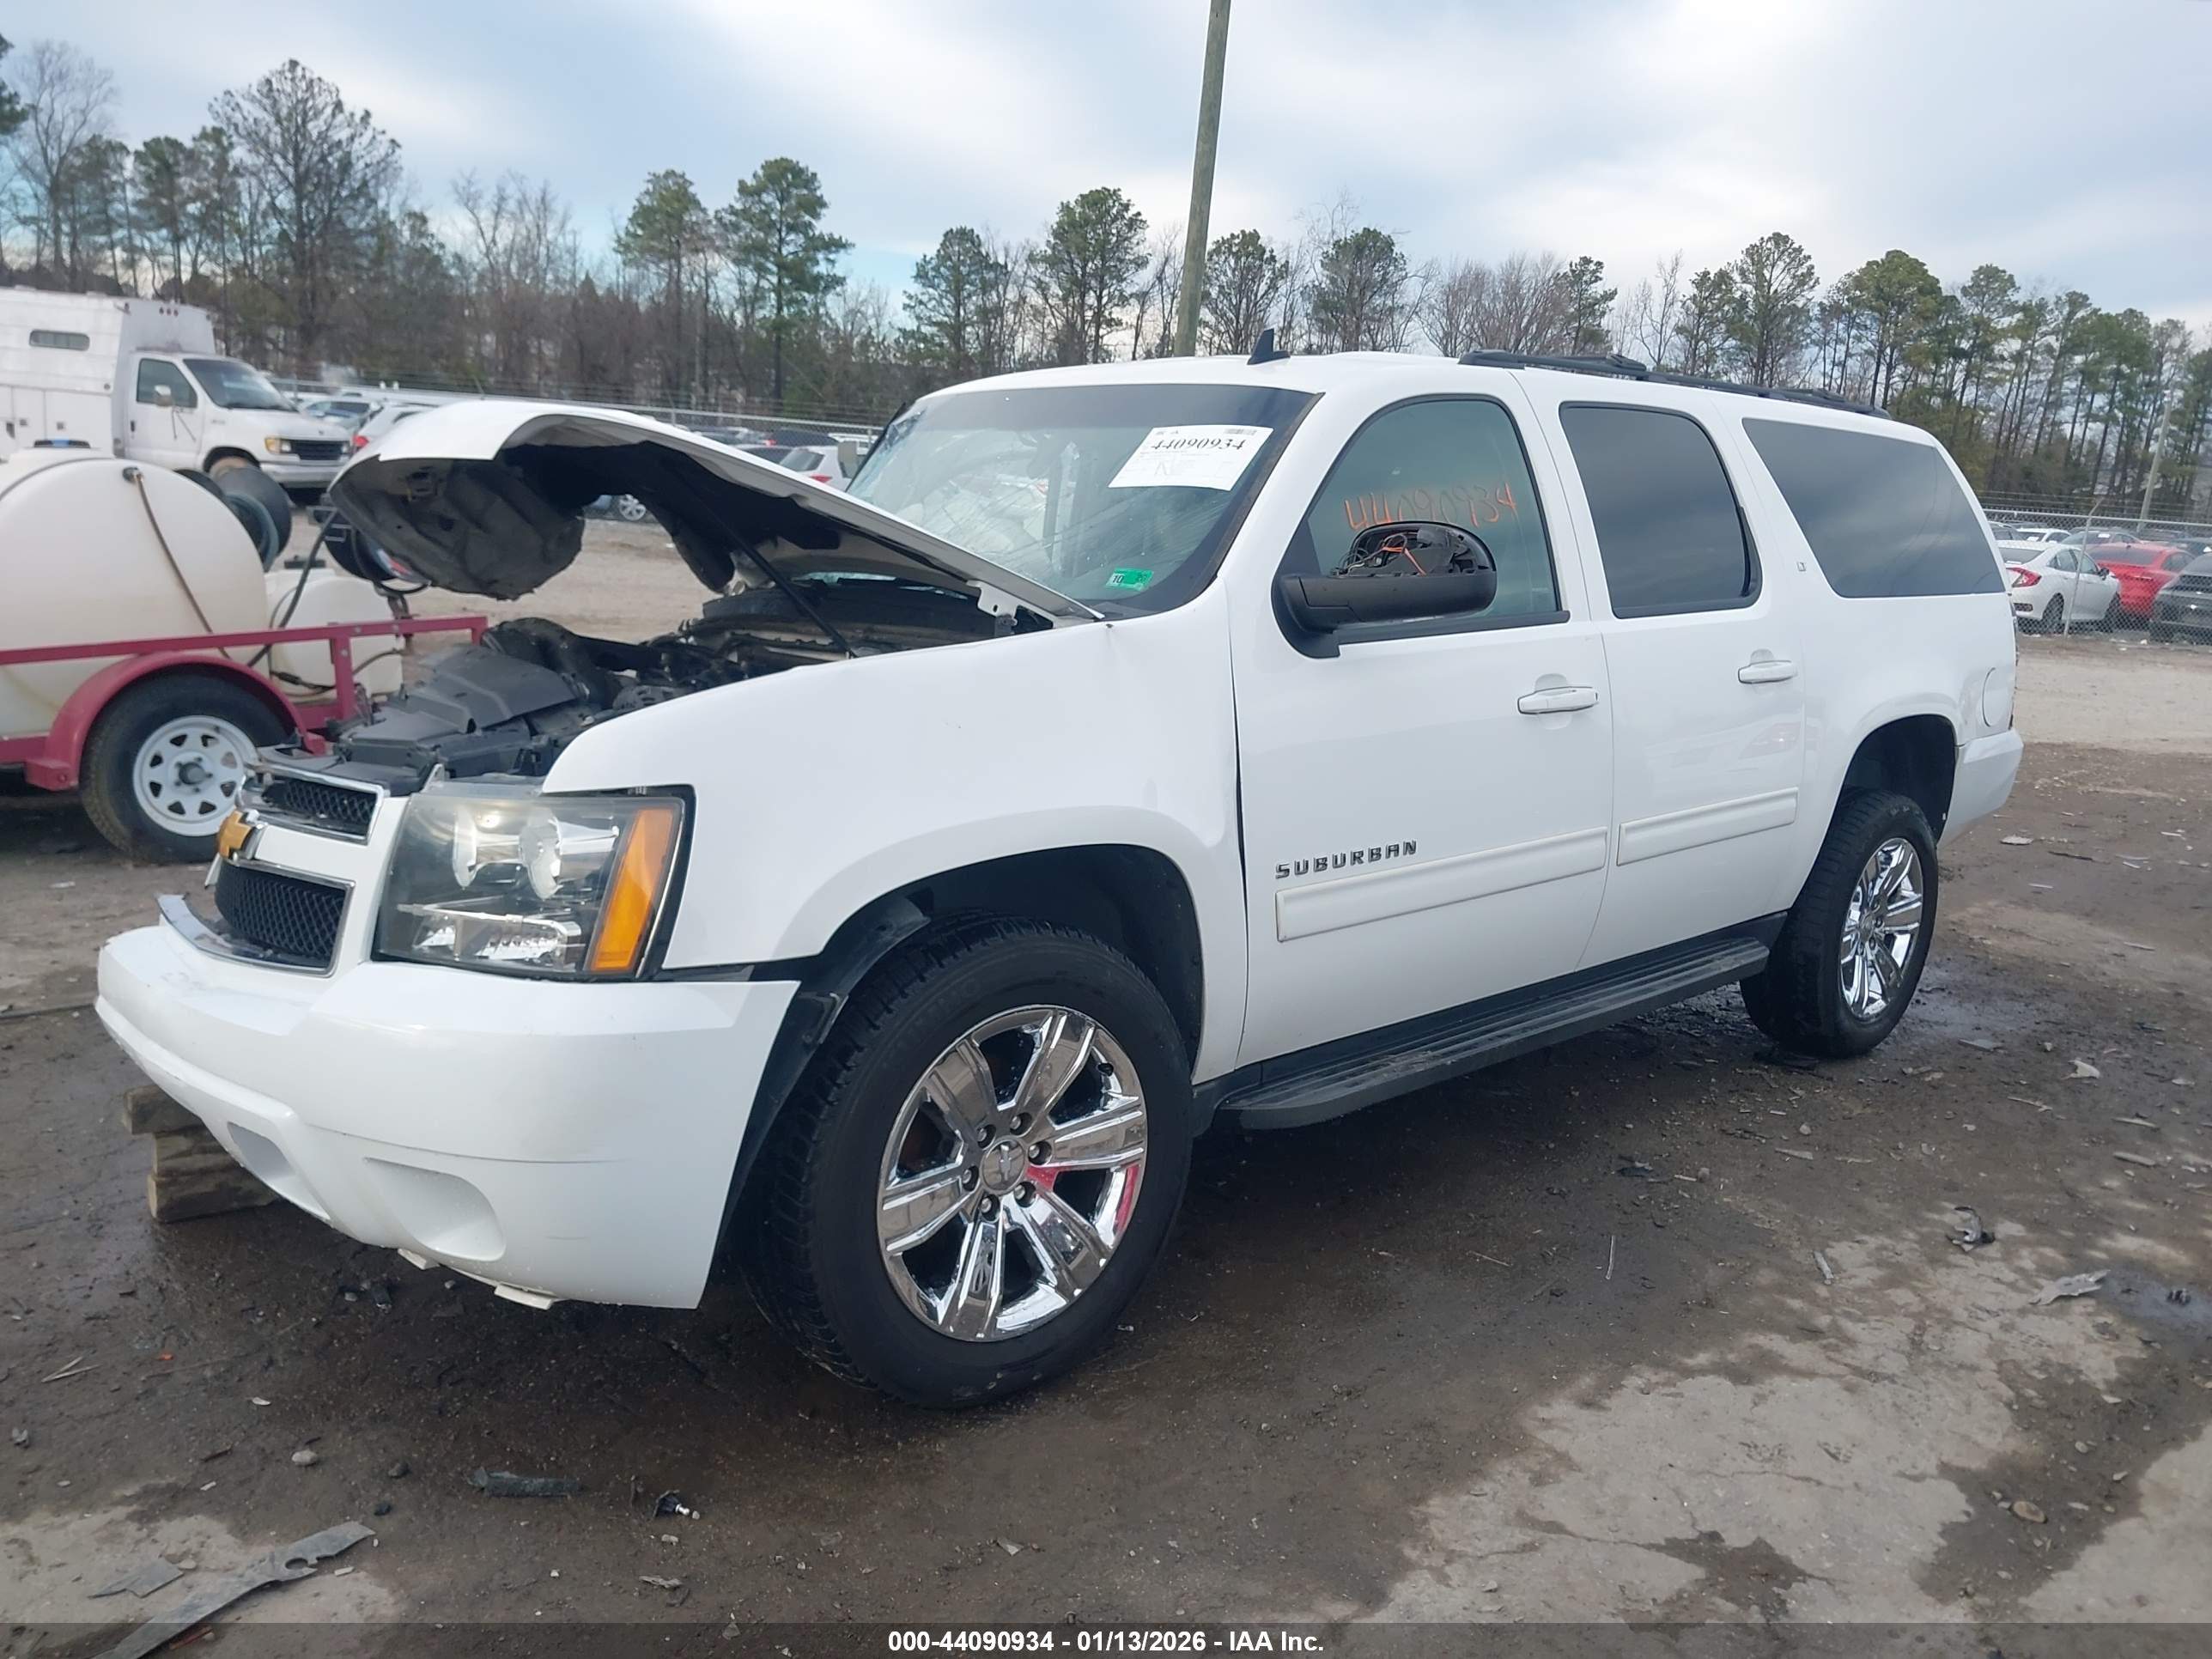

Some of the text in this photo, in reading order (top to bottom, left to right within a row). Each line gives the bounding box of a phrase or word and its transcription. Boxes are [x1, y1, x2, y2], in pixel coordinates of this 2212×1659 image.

[1152, 439, 1246, 450] 44090934
[1345, 483, 1517, 530] 44090934
[1275, 840, 1417, 879] SUBURBAN
